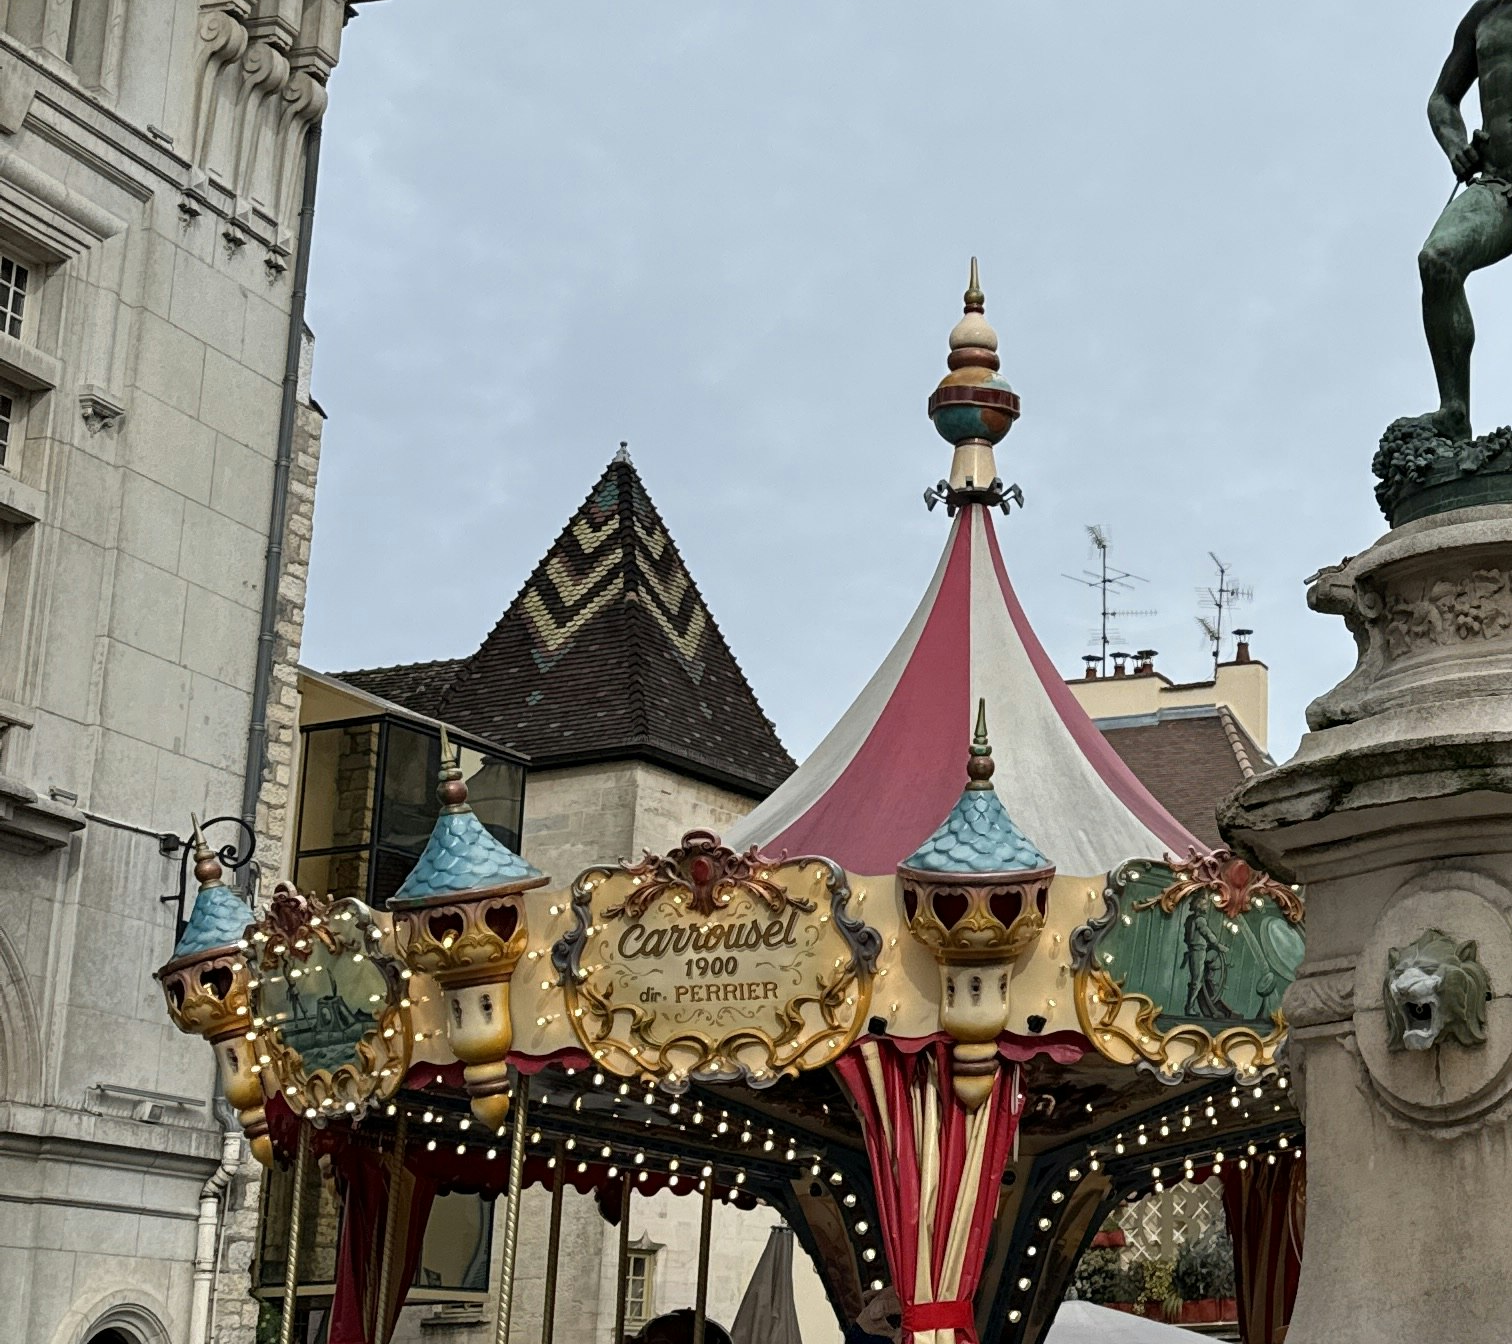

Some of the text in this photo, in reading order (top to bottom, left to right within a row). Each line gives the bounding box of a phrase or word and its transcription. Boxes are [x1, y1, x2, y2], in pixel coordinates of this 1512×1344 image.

[617, 908, 797, 959] Carrousel
[685, 956, 739, 978] 1900
[639, 981, 779, 1003] dir. PERRIER
